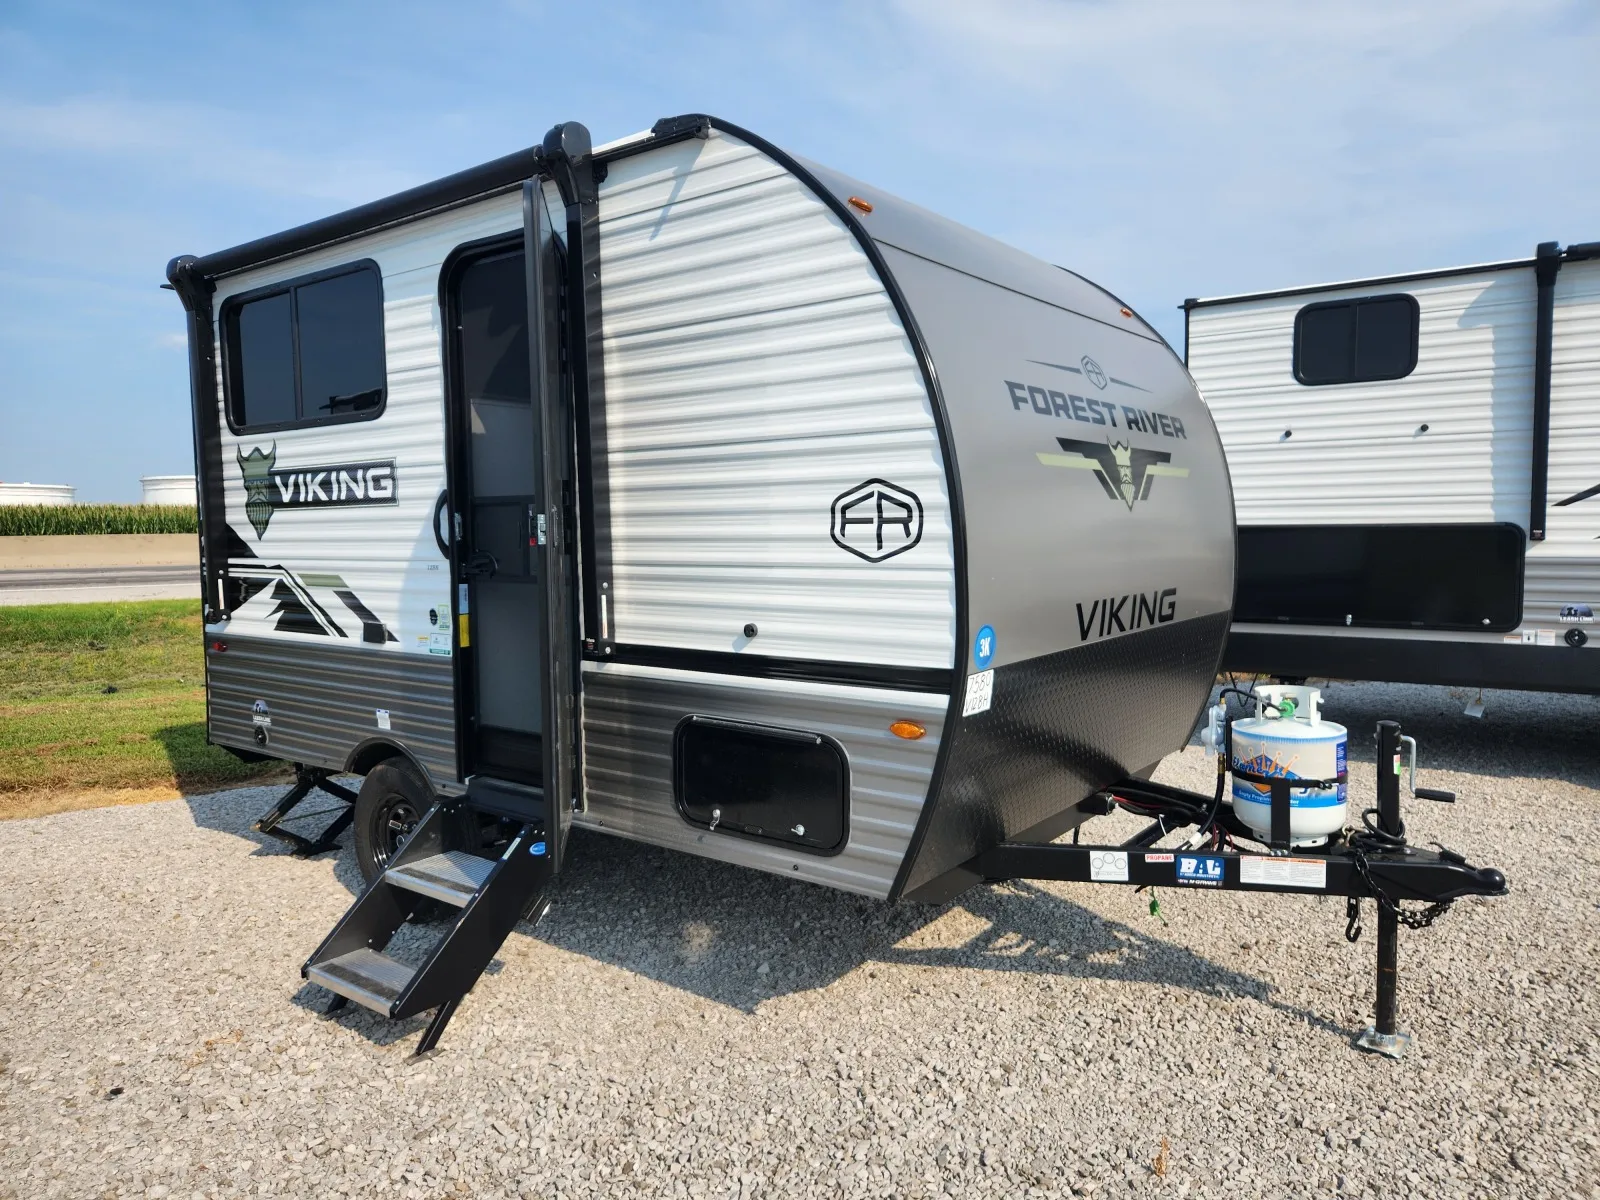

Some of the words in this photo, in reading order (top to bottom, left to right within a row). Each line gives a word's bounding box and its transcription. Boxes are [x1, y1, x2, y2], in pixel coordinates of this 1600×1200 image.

[1004, 380, 1118, 428] FOREST
[1120, 404, 1188, 440] RIVER
[273, 466, 393, 504] VIKING
[1075, 587, 1178, 642] VIKING
[979, 636, 991, 658] 3K
[968, 671, 992, 694] 7580
